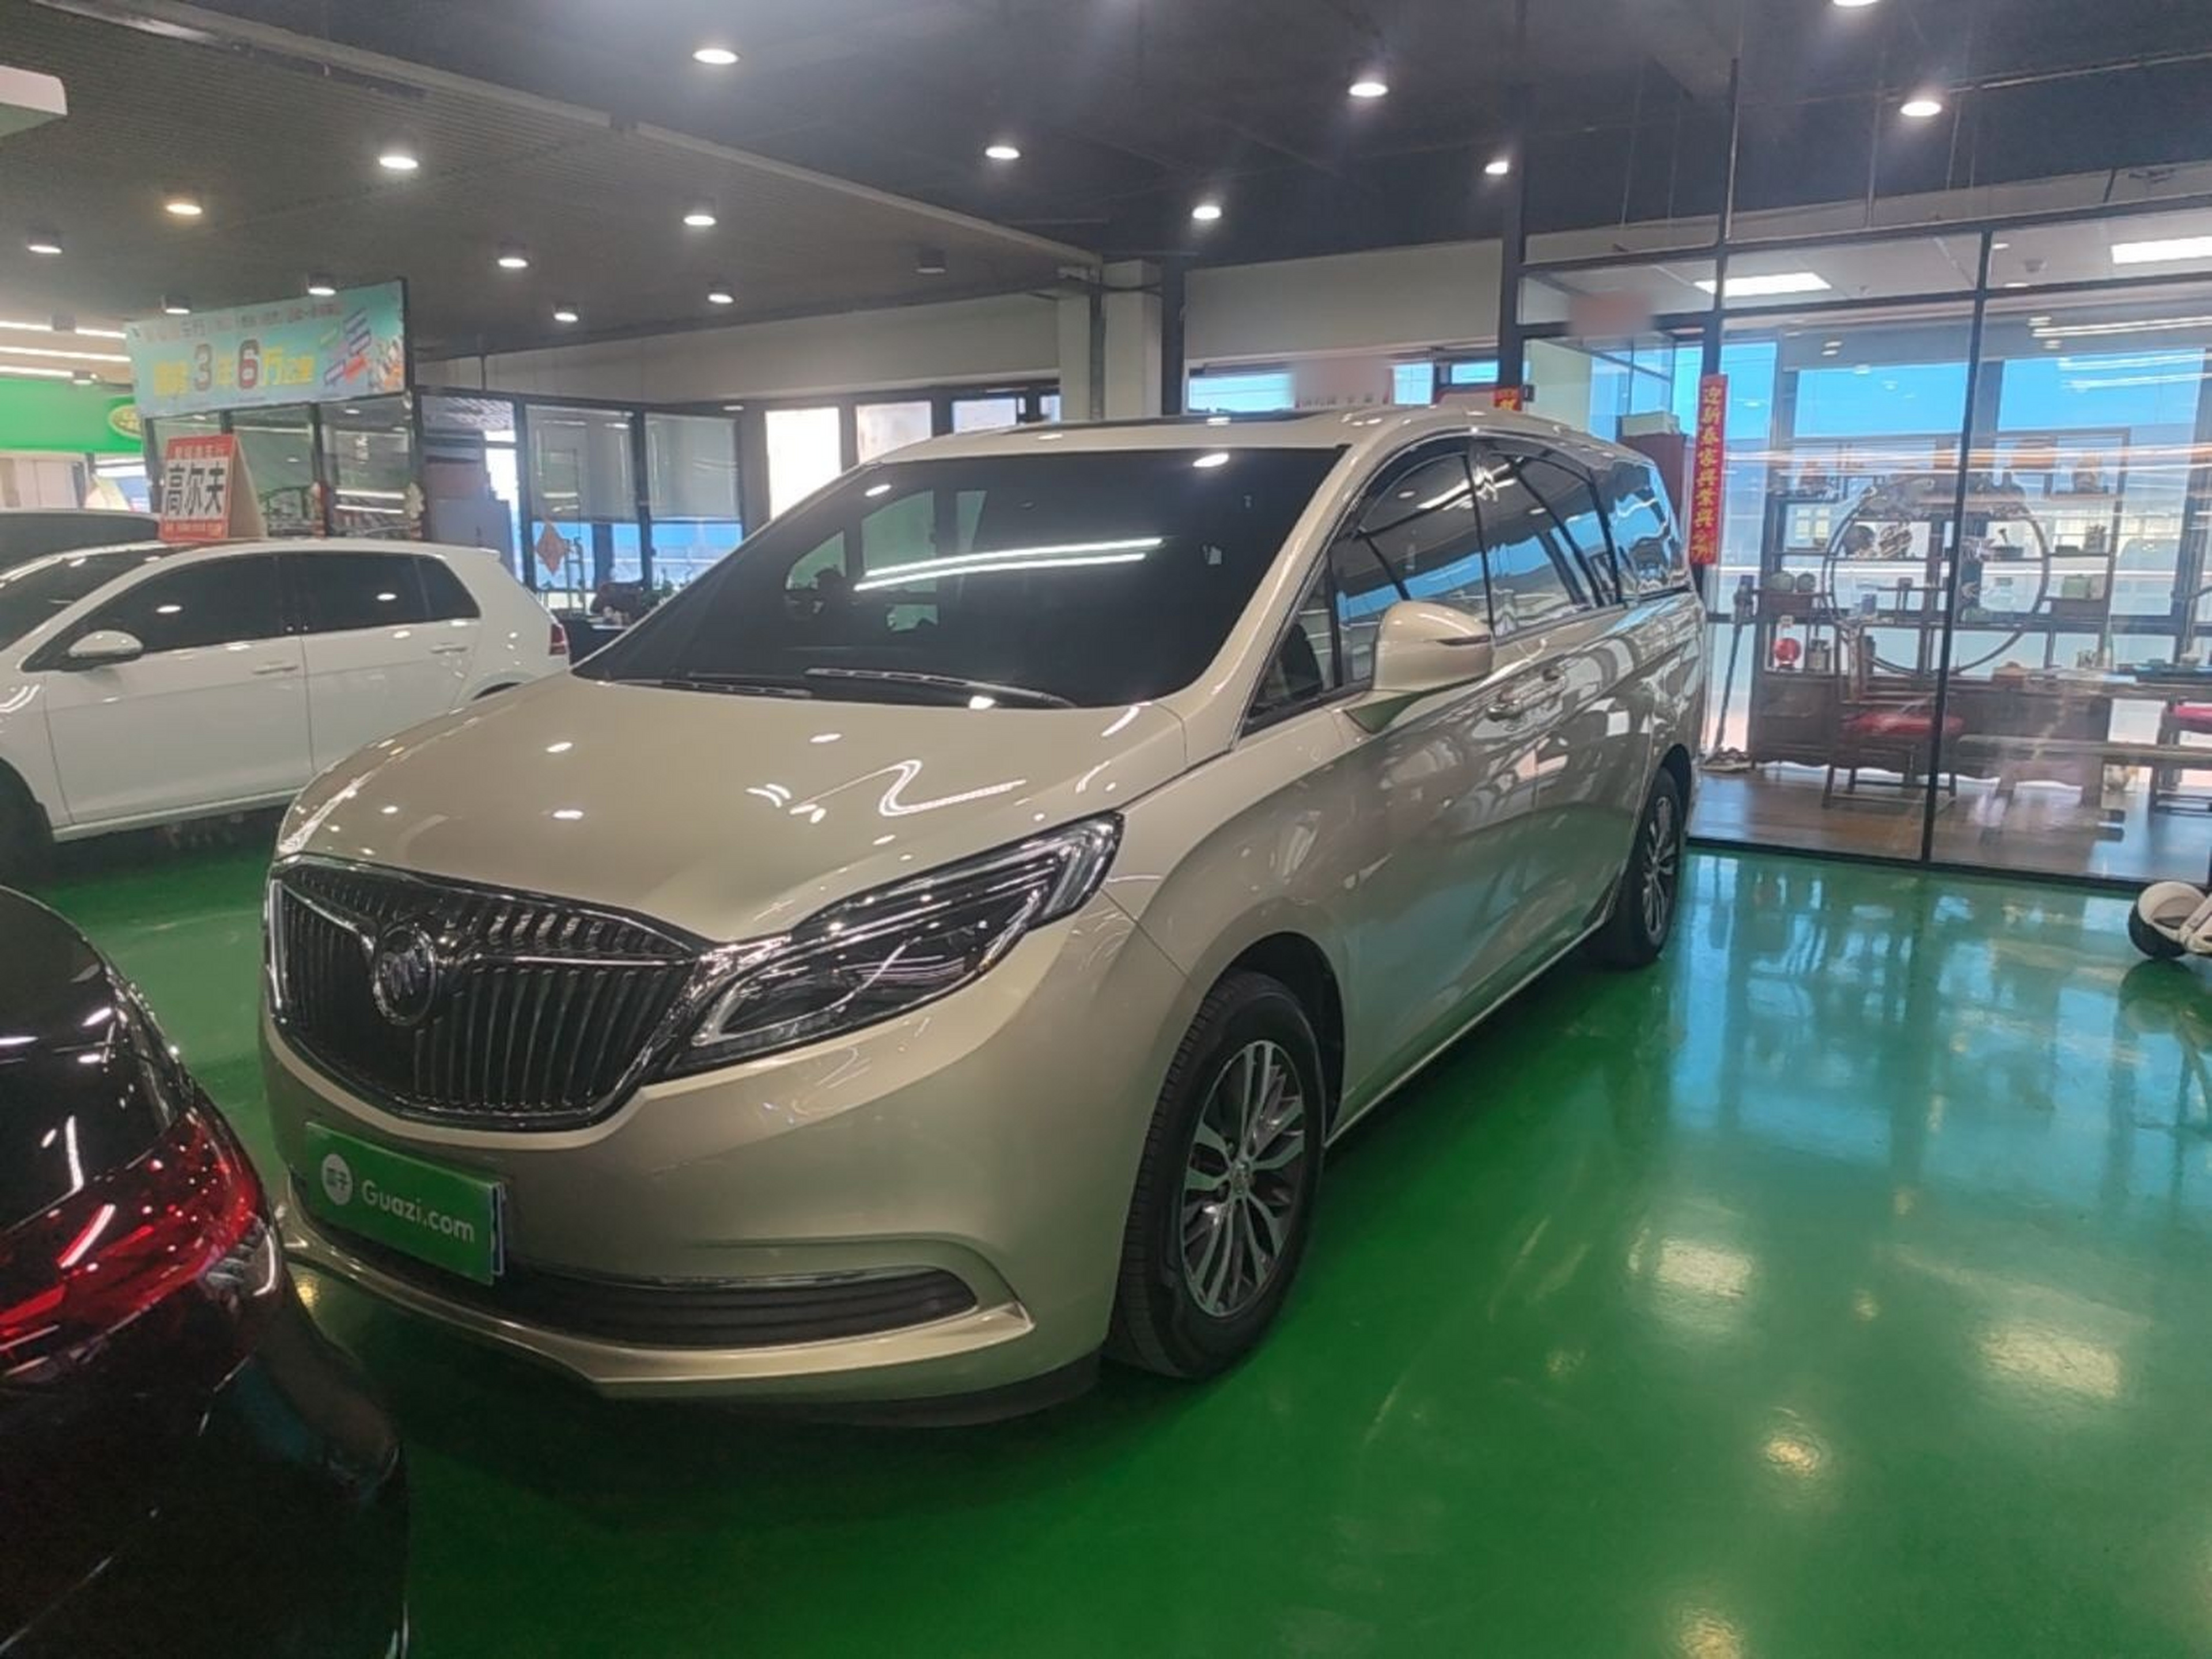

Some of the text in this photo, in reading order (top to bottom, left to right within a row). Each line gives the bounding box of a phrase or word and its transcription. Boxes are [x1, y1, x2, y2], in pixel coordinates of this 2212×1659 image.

[166, 462, 225, 515] 高尔夫
[361, 1179, 475, 1243] Guazi.com
